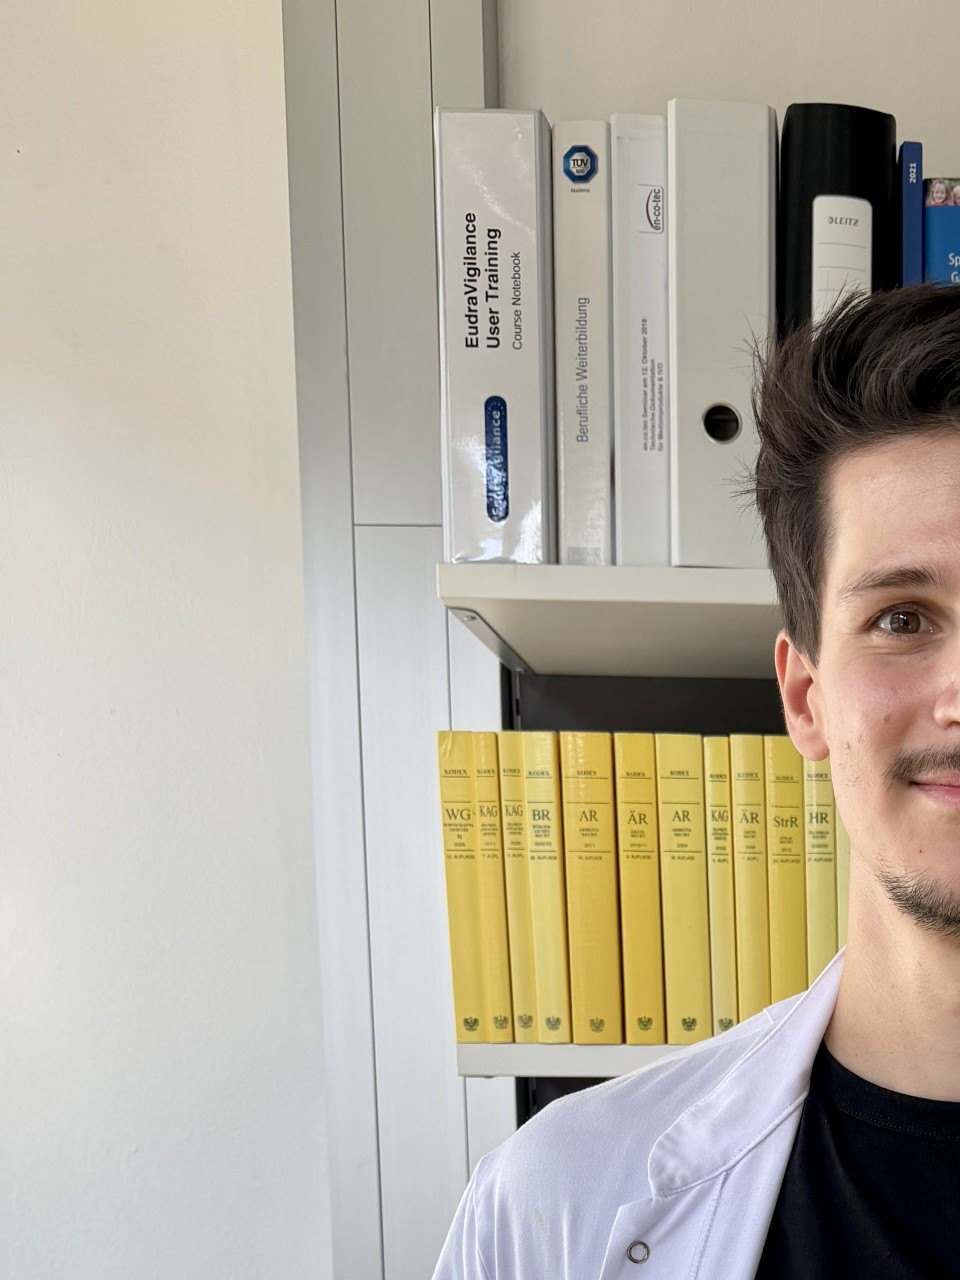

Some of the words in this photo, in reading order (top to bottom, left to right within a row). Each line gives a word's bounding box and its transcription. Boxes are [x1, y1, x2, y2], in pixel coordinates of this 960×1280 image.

[909, 162, 917, 184] 2021
[653, 188, 662, 231] en-co-tec
[834, 216, 859, 227] LEITZ
[485, 228, 502, 303] Training
[463, 212, 481, 348] EudraVigilance
[511, 251, 522, 306] Notebook
[486, 307, 501, 349] User
[511, 310, 523, 350] Course
[576, 297, 590, 382] Weiterbildung
[642, 377, 648, 389] am
[576, 384, 589, 443] Berufliche
[445, 809, 471, 821] WG
[479, 806, 497, 818] KAG
[505, 805, 523, 817] KAG
[532, 809, 551, 821] BR
[579, 810, 598, 822] AR
[672, 810, 691, 822] AR
[711, 809, 729, 822] KAG
[740, 809, 760, 824] ÄR
[627, 811, 648, 825] ÄR
[773, 816, 799, 828] StrR
[809, 812, 829, 824] HR
